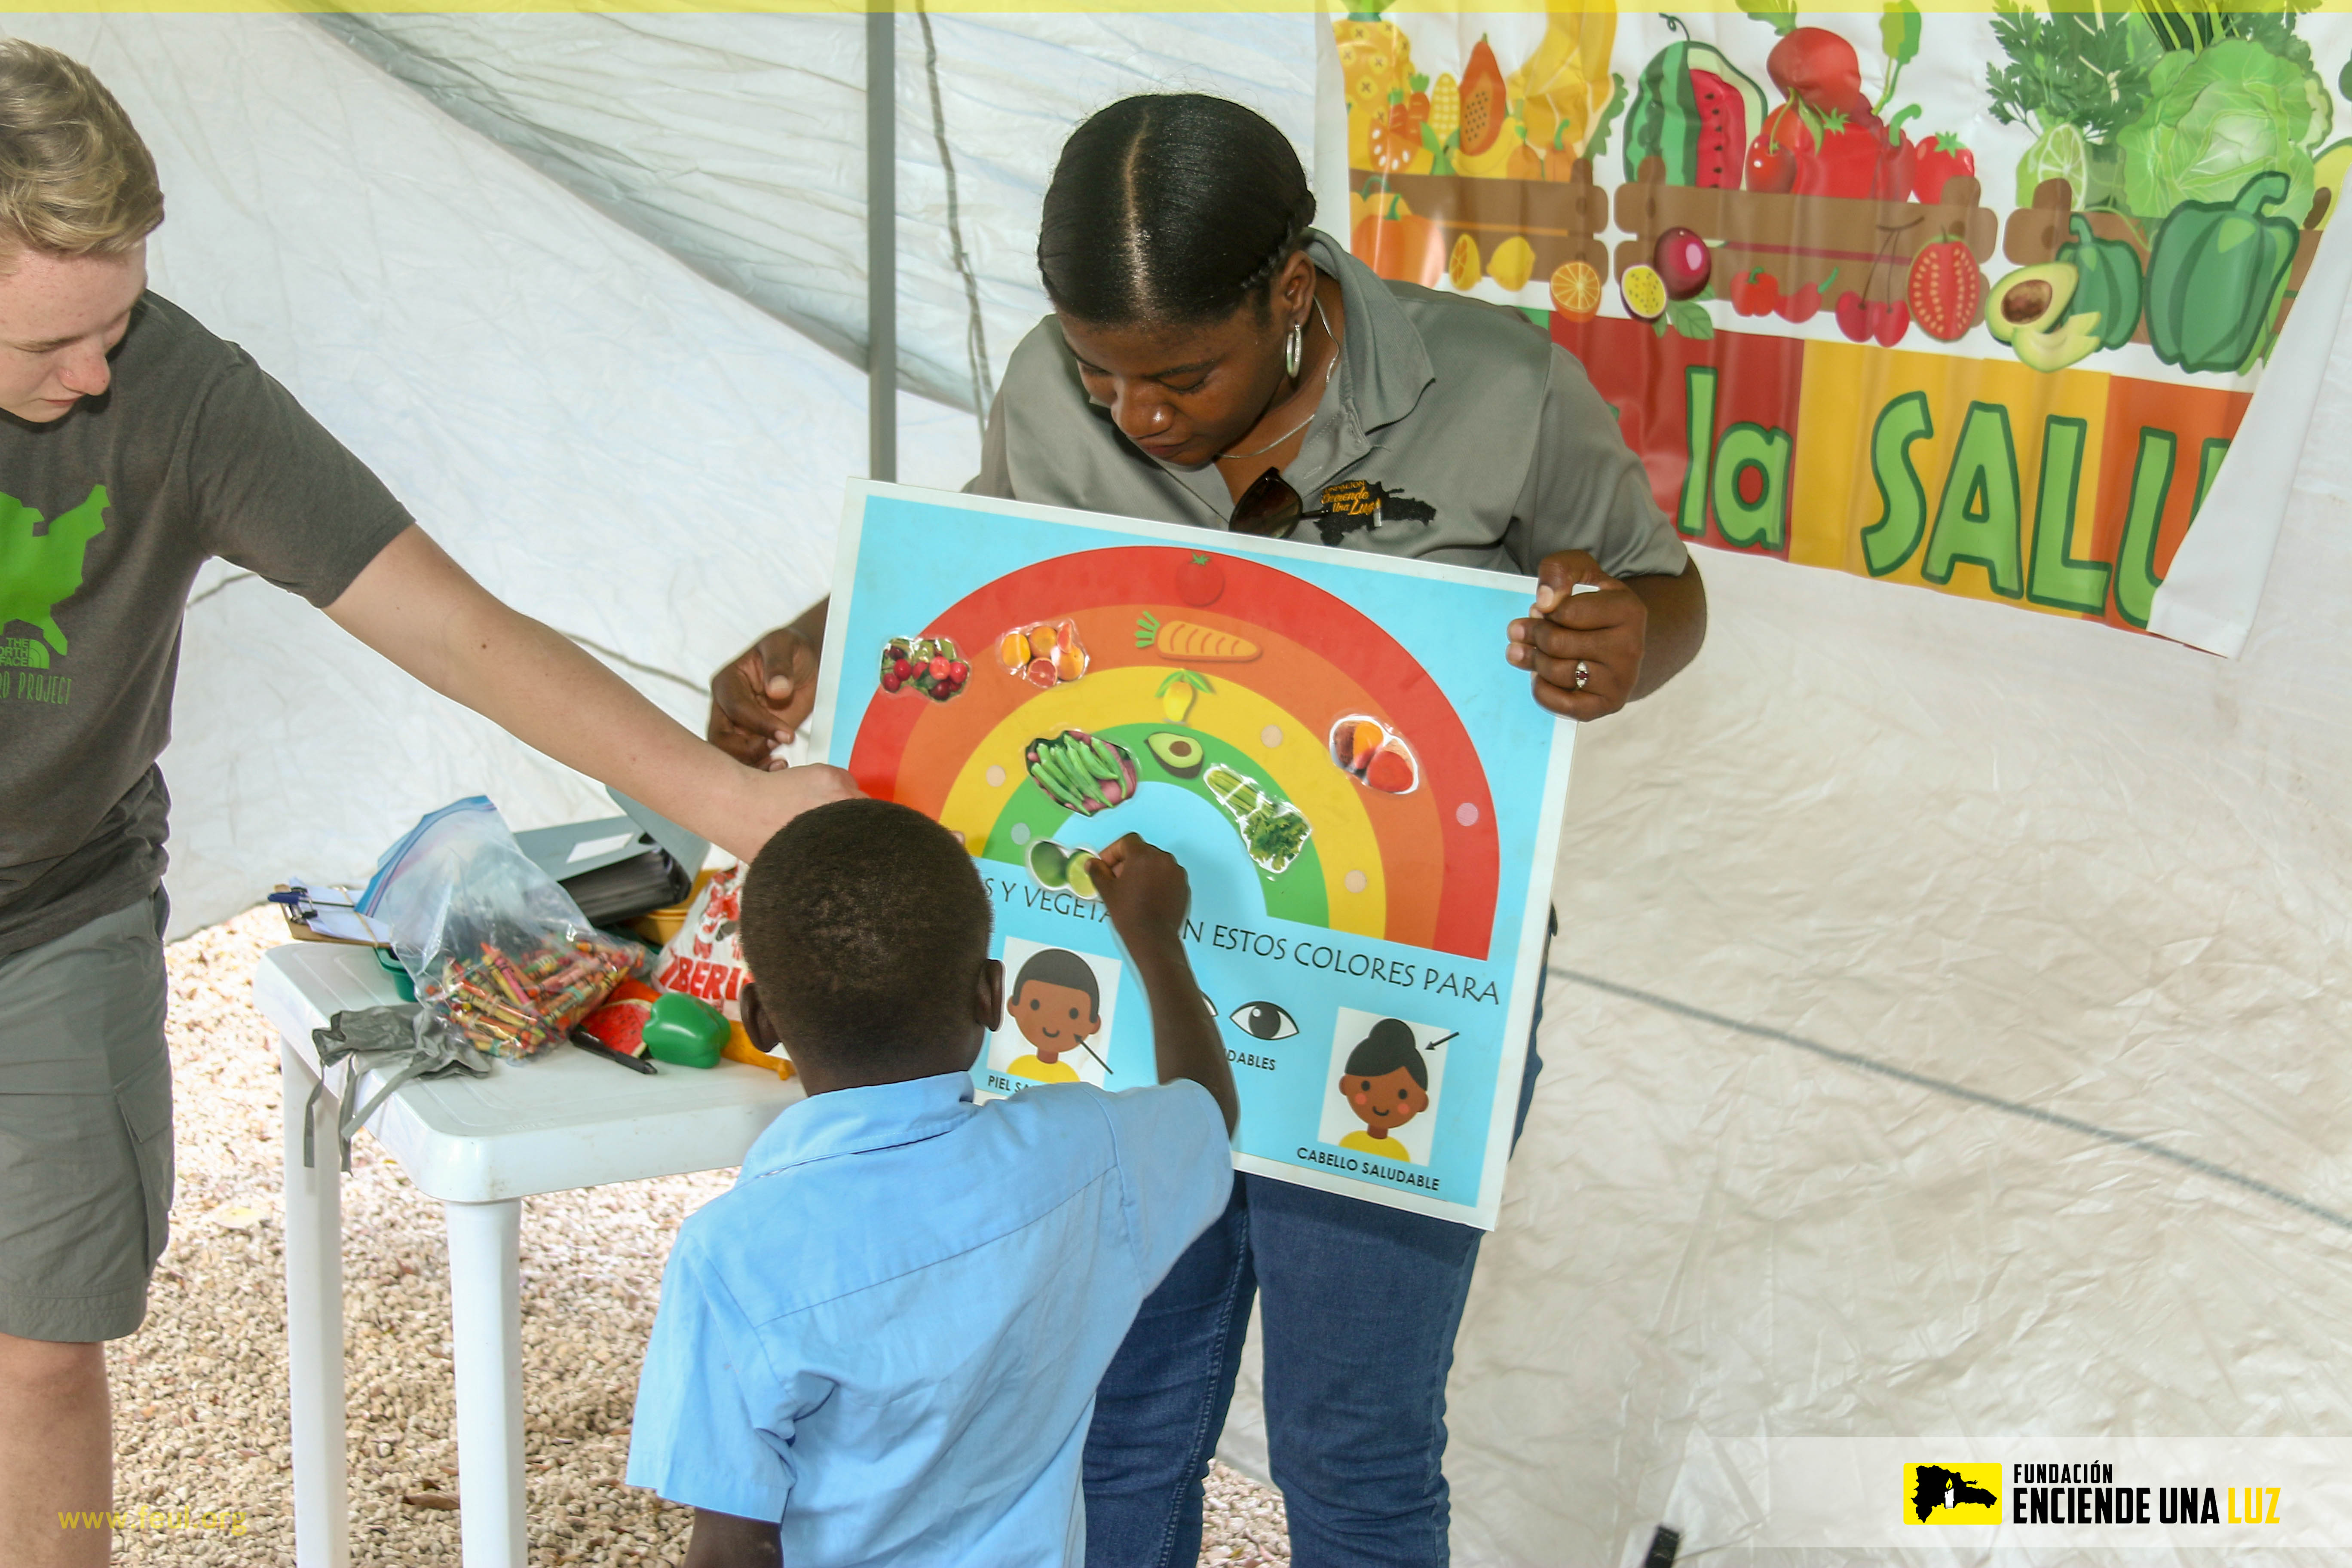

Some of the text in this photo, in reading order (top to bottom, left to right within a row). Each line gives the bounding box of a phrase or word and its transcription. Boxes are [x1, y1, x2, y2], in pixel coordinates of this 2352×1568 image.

[1677, 364, 2232, 630] la SALU
[0, 646, 29, 657] ORTH
[6, 637, 29, 648] THE
[18, 672, 73, 705] PROJECT
[1001, 881, 1017, 903] Y
[1213, 924, 1287, 960] ESTOS
[1294, 942, 1415, 987] COLORES
[1423, 968, 1499, 1005] PARA
[1226, 1049, 1276, 1071] DABLES
[988, 1075, 1011, 1091] PIEL
[1296, 1147, 1440, 1191] CABELLO SALUDABLE
